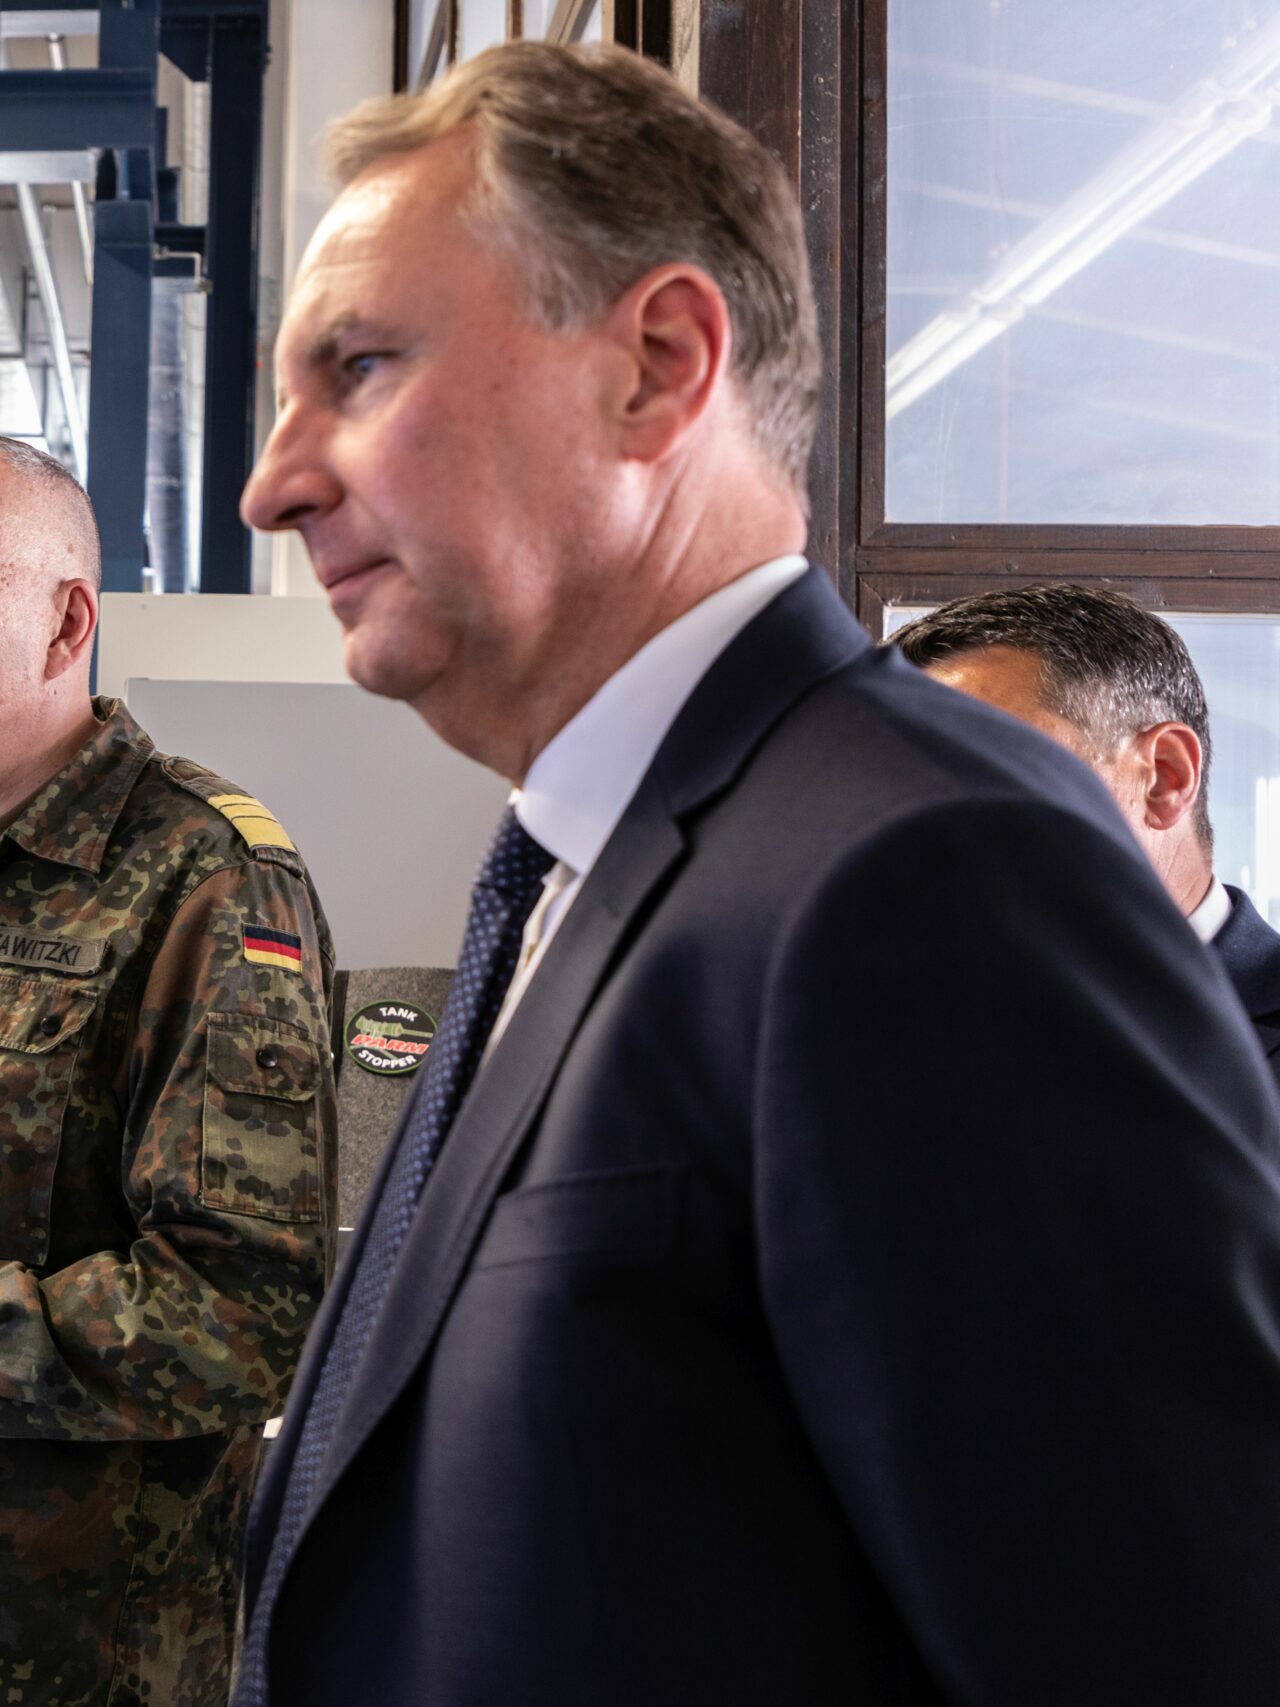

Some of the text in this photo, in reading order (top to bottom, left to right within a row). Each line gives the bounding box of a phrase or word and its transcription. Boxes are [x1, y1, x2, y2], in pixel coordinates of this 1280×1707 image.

[379, 1007, 418, 1022] TANK
[350, 1034, 430, 1055] PARM
[358, 1049, 417, 1069] STOPPER
